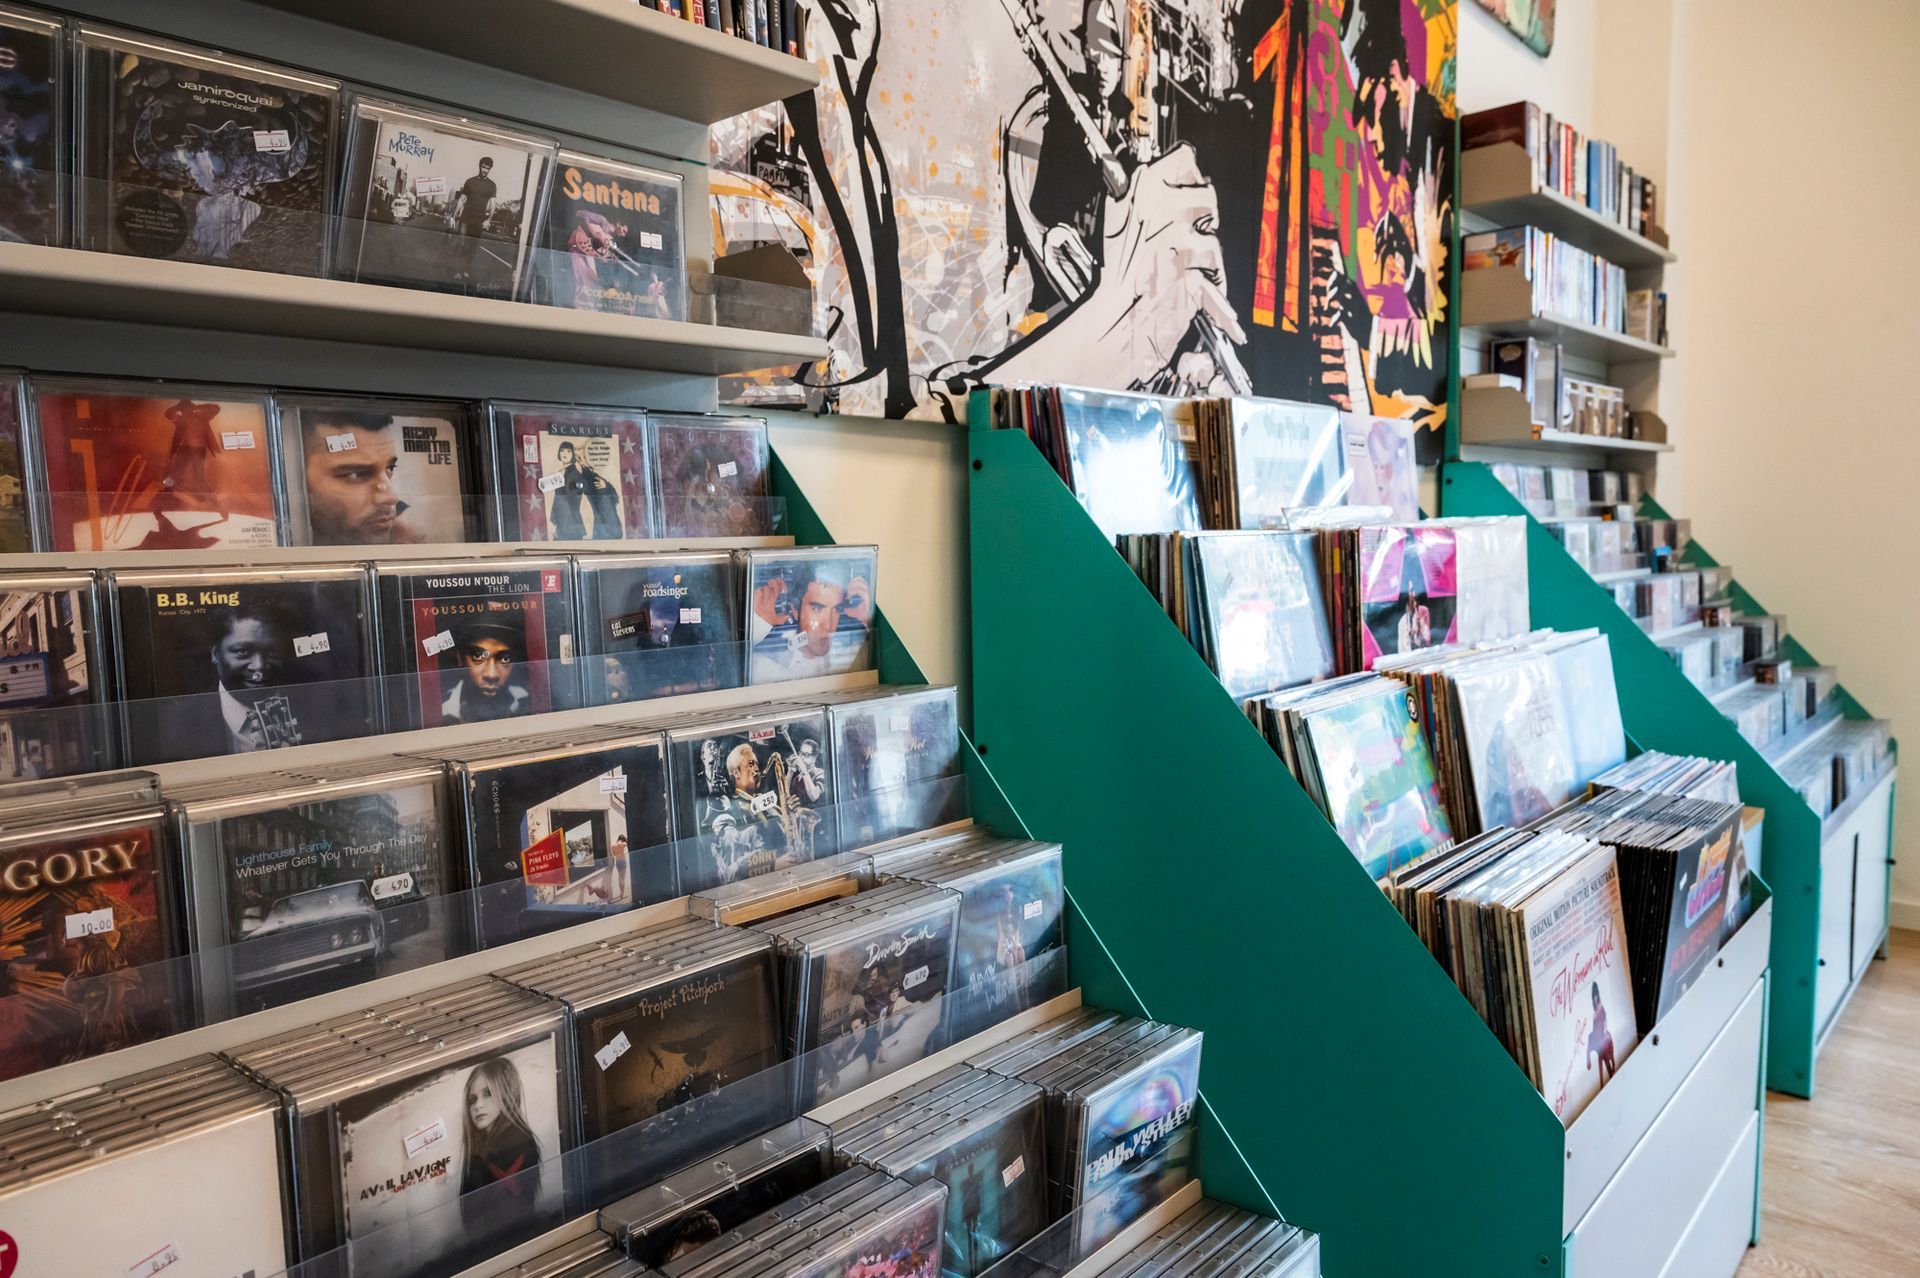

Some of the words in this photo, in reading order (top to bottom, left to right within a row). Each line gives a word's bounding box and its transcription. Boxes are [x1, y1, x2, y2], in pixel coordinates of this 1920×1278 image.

[178, 81, 273, 107] Jamiroquai
[193, 95, 257, 112] Synkronized
[399, 131, 422, 146] Pete
[389, 138, 435, 164] Murray
[563, 167, 660, 216] Santana
[428, 453, 451, 464] LIFE
[426, 578, 471, 588] YOUSSOU
[474, 575, 510, 587] N'DOUR
[487, 585, 506, 594] THE
[508, 583, 530, 593] LION
[157, 593, 194, 607] B.B.
[200, 591, 240, 607] King
[643, 585, 688, 599] roadsinger
[422, 603, 484, 616] YOUSSOU
[612, 625, 636, 638] stevens
[310, 640, 328, 650] 4.90
[751, 729, 775, 739] JAZZ
[235, 848, 296, 867] Lighthouse
[299, 839, 333, 855] Family
[236, 861, 289, 880] Whatever
[291, 855, 318, 868] Gets
[320, 849, 341, 863] You
[343, 840, 386, 858] Through
[388, 837, 407, 849] The
[409, 832, 428, 845] Day
[3, 840, 140, 892] GORY
[81, 919, 112, 934] 10.00
[1529, 912, 1554, 941] ORIGINAL
[639, 989, 677, 1019] Project
[680, 974, 725, 1005] Pitchfork
[360, 1178, 396, 1201] AVRIL
[400, 1156, 451, 1184] LAVIGNE
